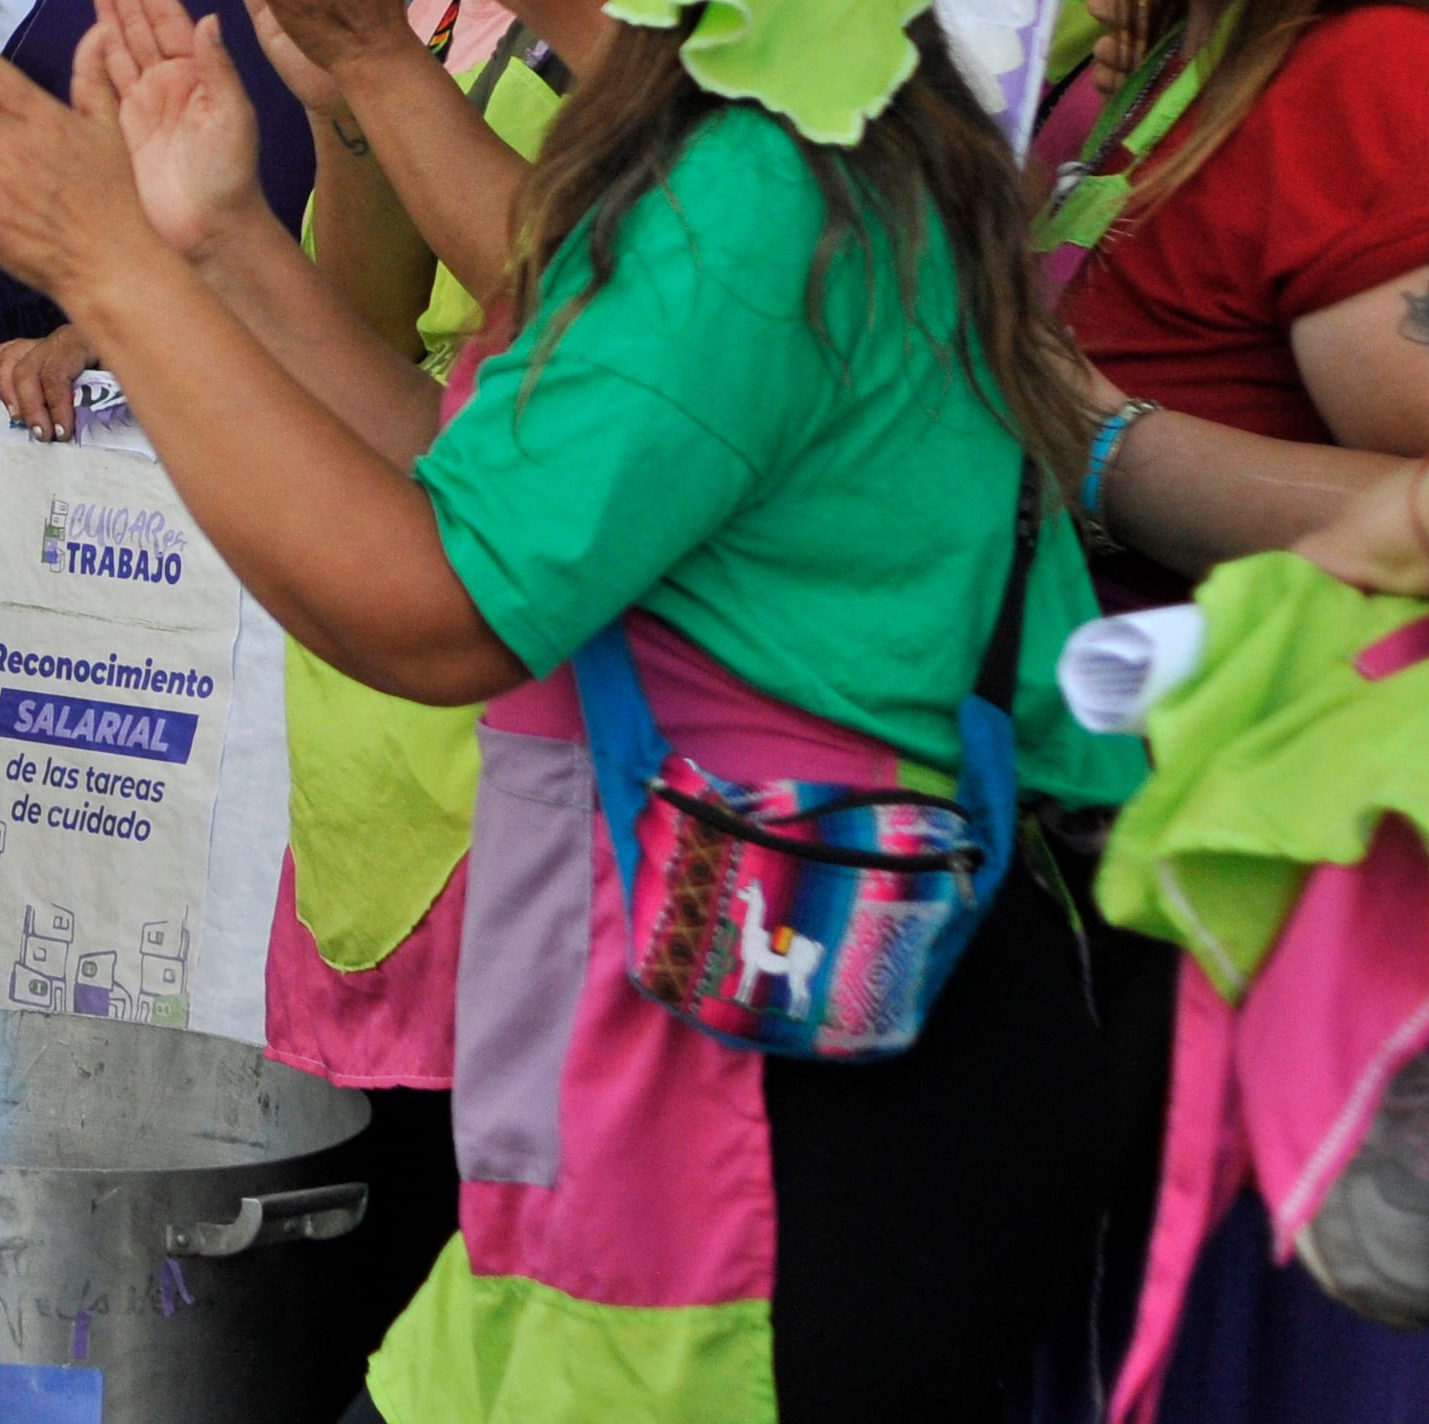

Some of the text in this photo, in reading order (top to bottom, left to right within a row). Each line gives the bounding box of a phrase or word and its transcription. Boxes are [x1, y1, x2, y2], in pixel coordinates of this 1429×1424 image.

[67, 502, 165, 558] CUIDAR
[66, 541, 183, 586] TRABAJO
[13, 699, 169, 753] SALARIAL
[6, 753, 166, 803] de las tareas
[11, 794, 151, 842] de cuidado
